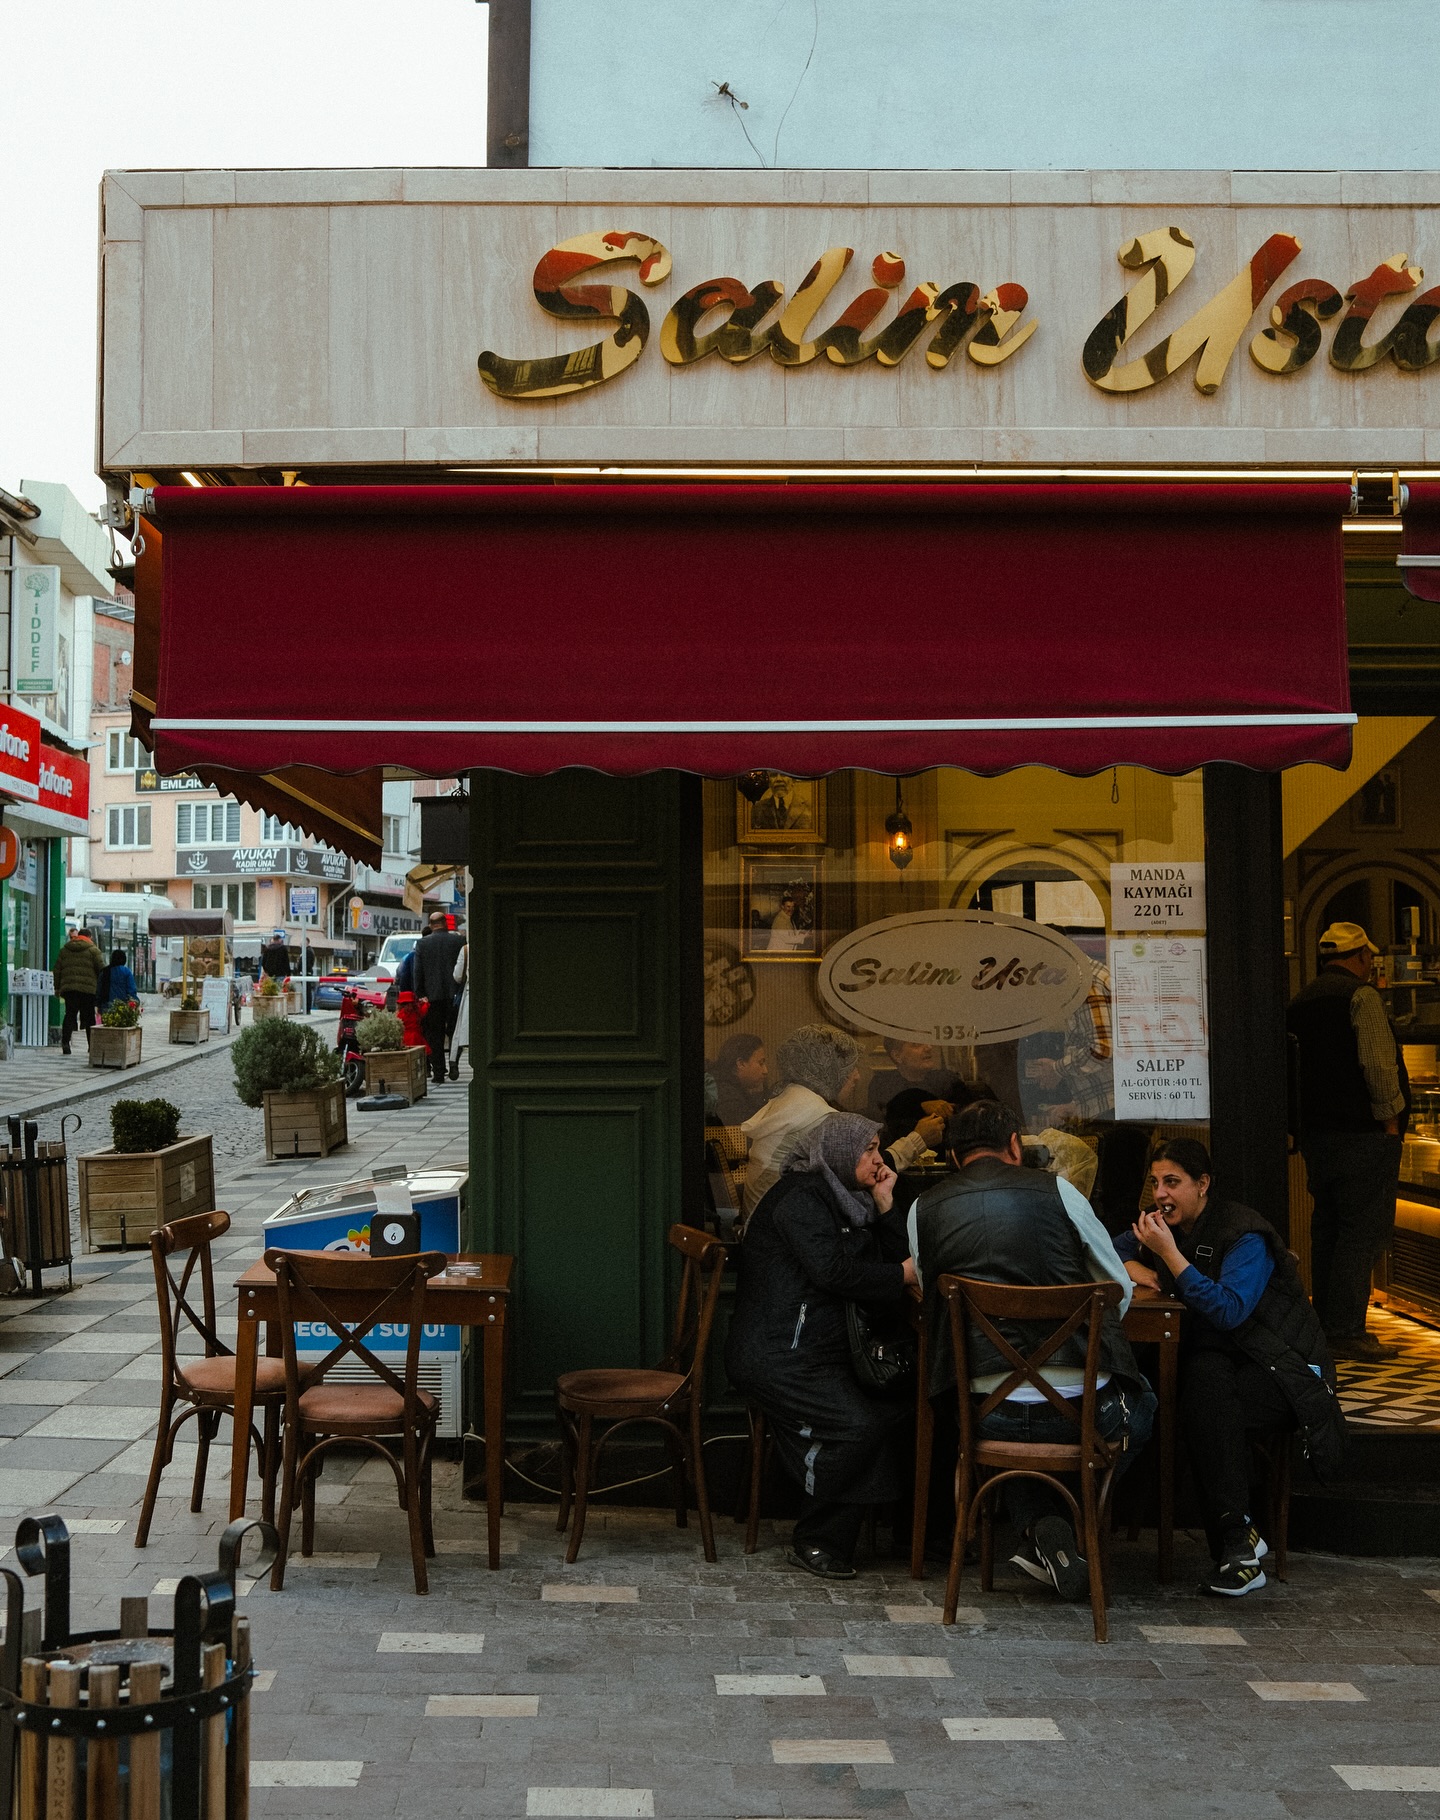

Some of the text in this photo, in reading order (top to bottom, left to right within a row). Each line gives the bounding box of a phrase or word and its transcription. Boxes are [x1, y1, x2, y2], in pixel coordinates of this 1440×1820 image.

[477, 229, 1039, 400] Salim
[232, 848, 280, 860] AVUKAT
[321, 853, 348, 868] AVUKAT
[235, 858, 276, 868] KADİR ÜNAL
[1130, 868, 1186, 881] MANDA
[1123, 883, 1193, 899] KAYMAĞI
[1133, 904, 1184, 916] 220 TL
[373, 914, 399, 931] KALE
[839, 956, 1066, 993] Salim Usta
[933, 1025, 979, 1041] 1934
[1136, 1059, 1185, 1073] SALEP
[1121, 1078, 1170, 1088] AL-GÖTÜR
[1190, 1078, 1202, 1086] TL
[1128, 1090, 1162, 1101] SERVİS
[1169, 1091, 1181, 1100] 60
[1183, 1091, 1196, 1100] TL
[390, 1232, 397, 1242] 6
